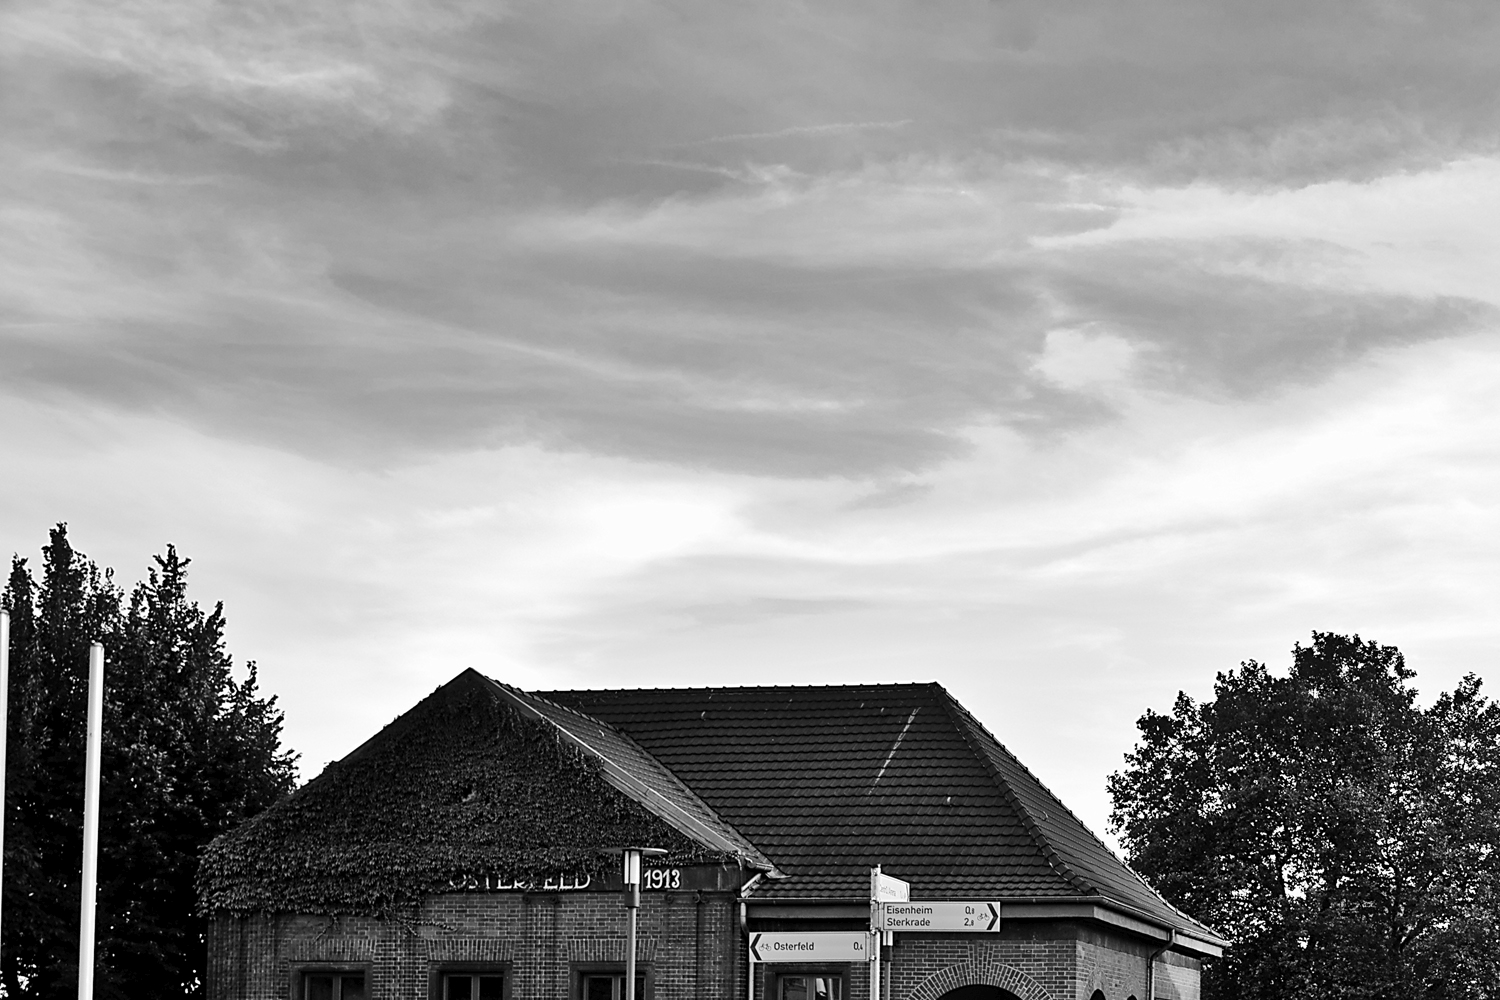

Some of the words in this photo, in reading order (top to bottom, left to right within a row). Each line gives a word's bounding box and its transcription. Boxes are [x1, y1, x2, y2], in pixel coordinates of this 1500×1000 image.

[644, 869, 680, 889] 1913
[886, 905, 933, 914] Eisenheim
[887, 917, 931, 927] Sterkrade
[773, 941, 815, 951] Osterfeld
